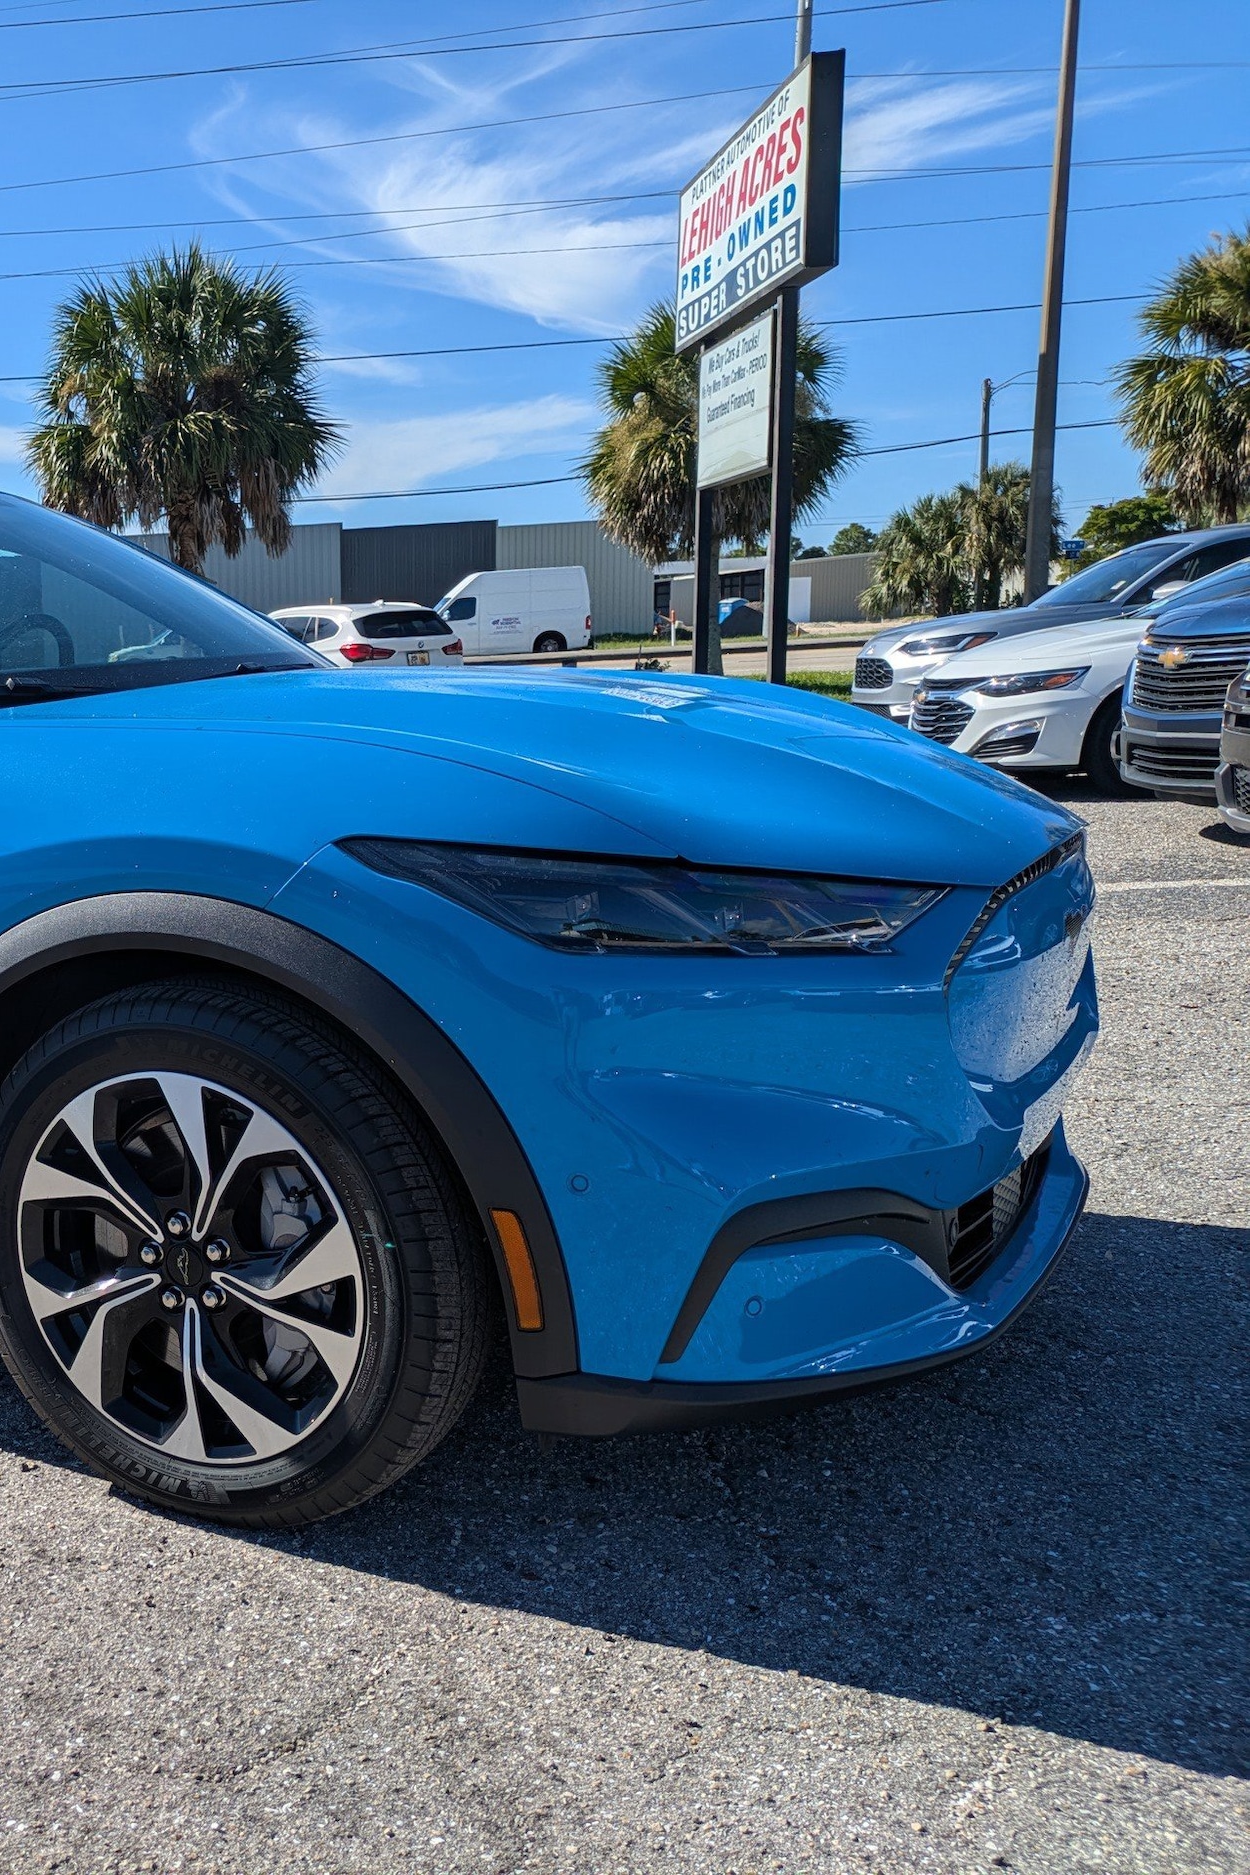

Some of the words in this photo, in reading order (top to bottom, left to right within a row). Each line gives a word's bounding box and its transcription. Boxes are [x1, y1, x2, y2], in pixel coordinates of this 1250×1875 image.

[681, 170, 737, 269] LEHIGH
[736, 106, 805, 219] ACRES
[692, 157, 725, 205] PLATTNER
[726, 103, 776, 169] AUTOMOTIVE
[777, 88, 790, 117] OF
[679, 281, 727, 338] SUPER
[736, 226, 797, 297] STORE
[724, 347, 736, 366] Cars
[748, 353, 768, 375] PERIOD
[707, 396, 730, 424] Guaranteed
[729, 387, 755, 412] Financing
[166, 1036, 306, 1117] MICHELIN
[59, 1405, 183, 1494] MICHELIN
